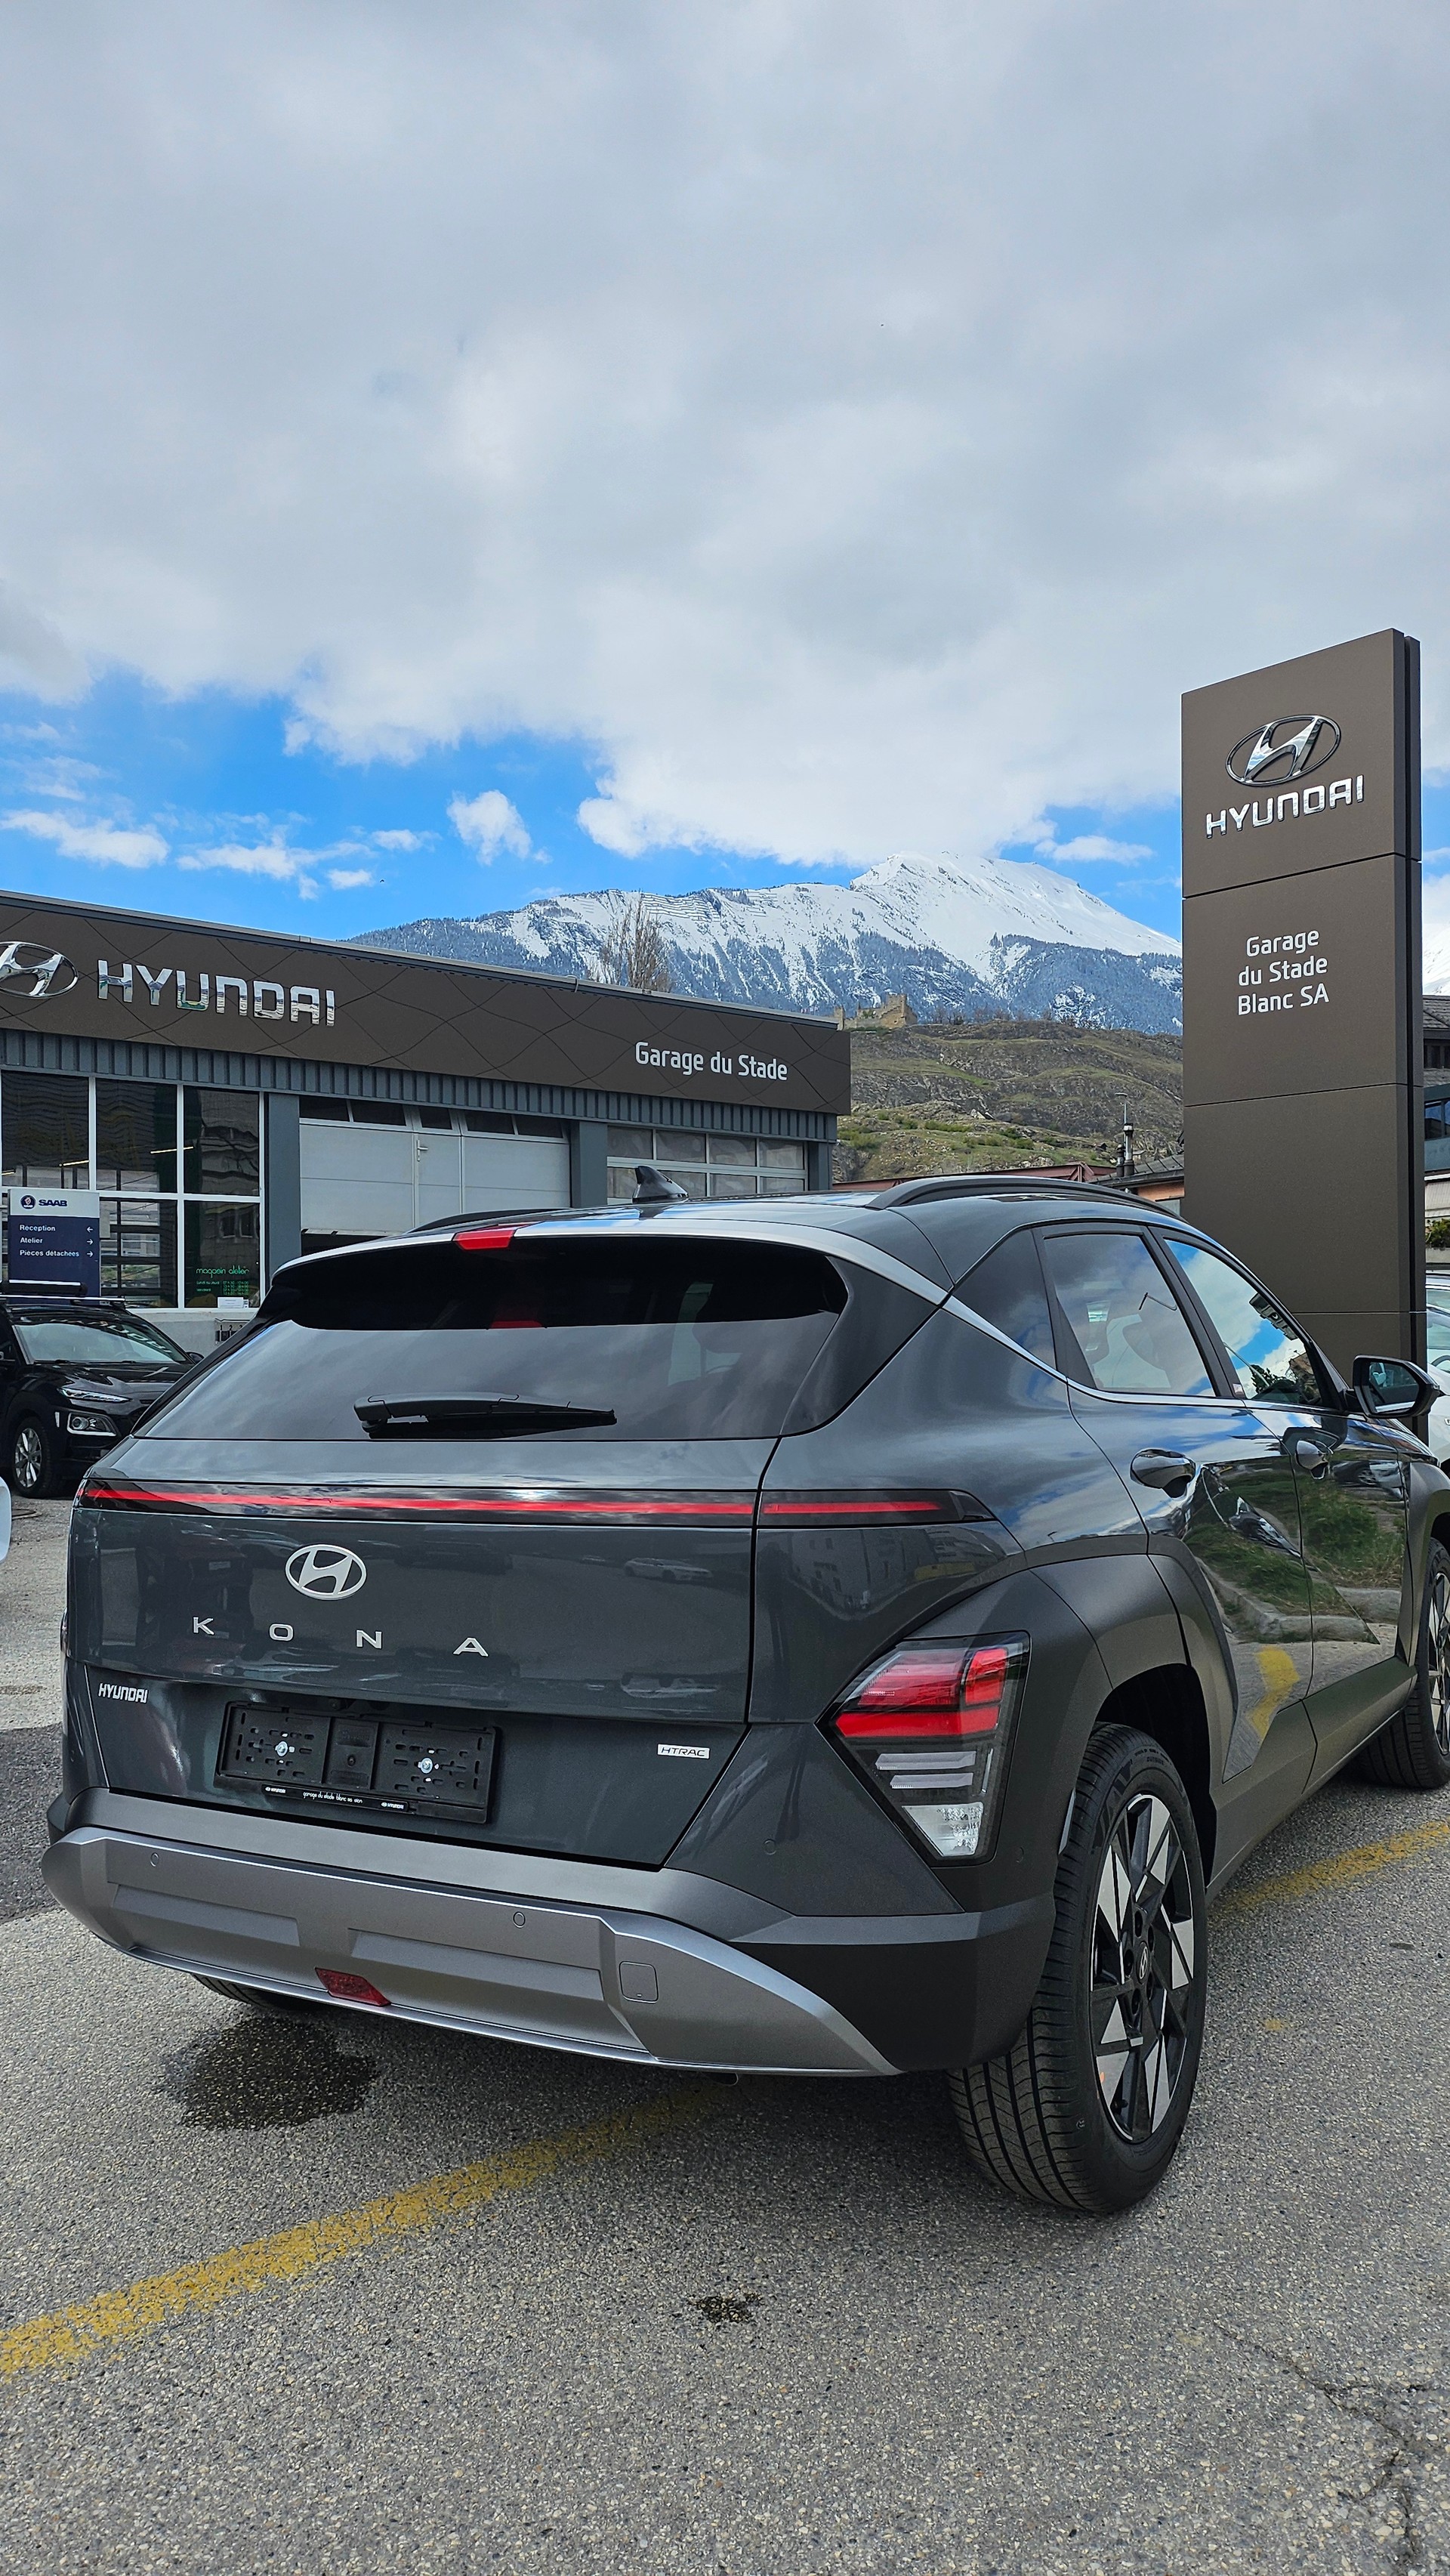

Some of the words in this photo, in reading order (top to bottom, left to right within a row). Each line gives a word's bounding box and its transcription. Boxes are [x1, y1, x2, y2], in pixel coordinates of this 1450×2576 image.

[1206, 774, 1364, 839] HYUNDAI
[1246, 930, 1319, 957] Garage
[1239, 965, 1262, 987] du
[1269, 955, 1328, 983] Stade
[97, 959, 335, 1027] HYUNDAI
[1238, 993, 1294, 1015] Blanc
[1300, 983, 1330, 1007] SA
[635, 1042, 704, 1076] Garage
[710, 1051, 732, 1075] du
[738, 1054, 788, 1081] Stade
[193, 1617, 489, 1657] KONA
[98, 1682, 148, 1703] HYUNDAI
[661, 1747, 705, 1756] HTRAC
